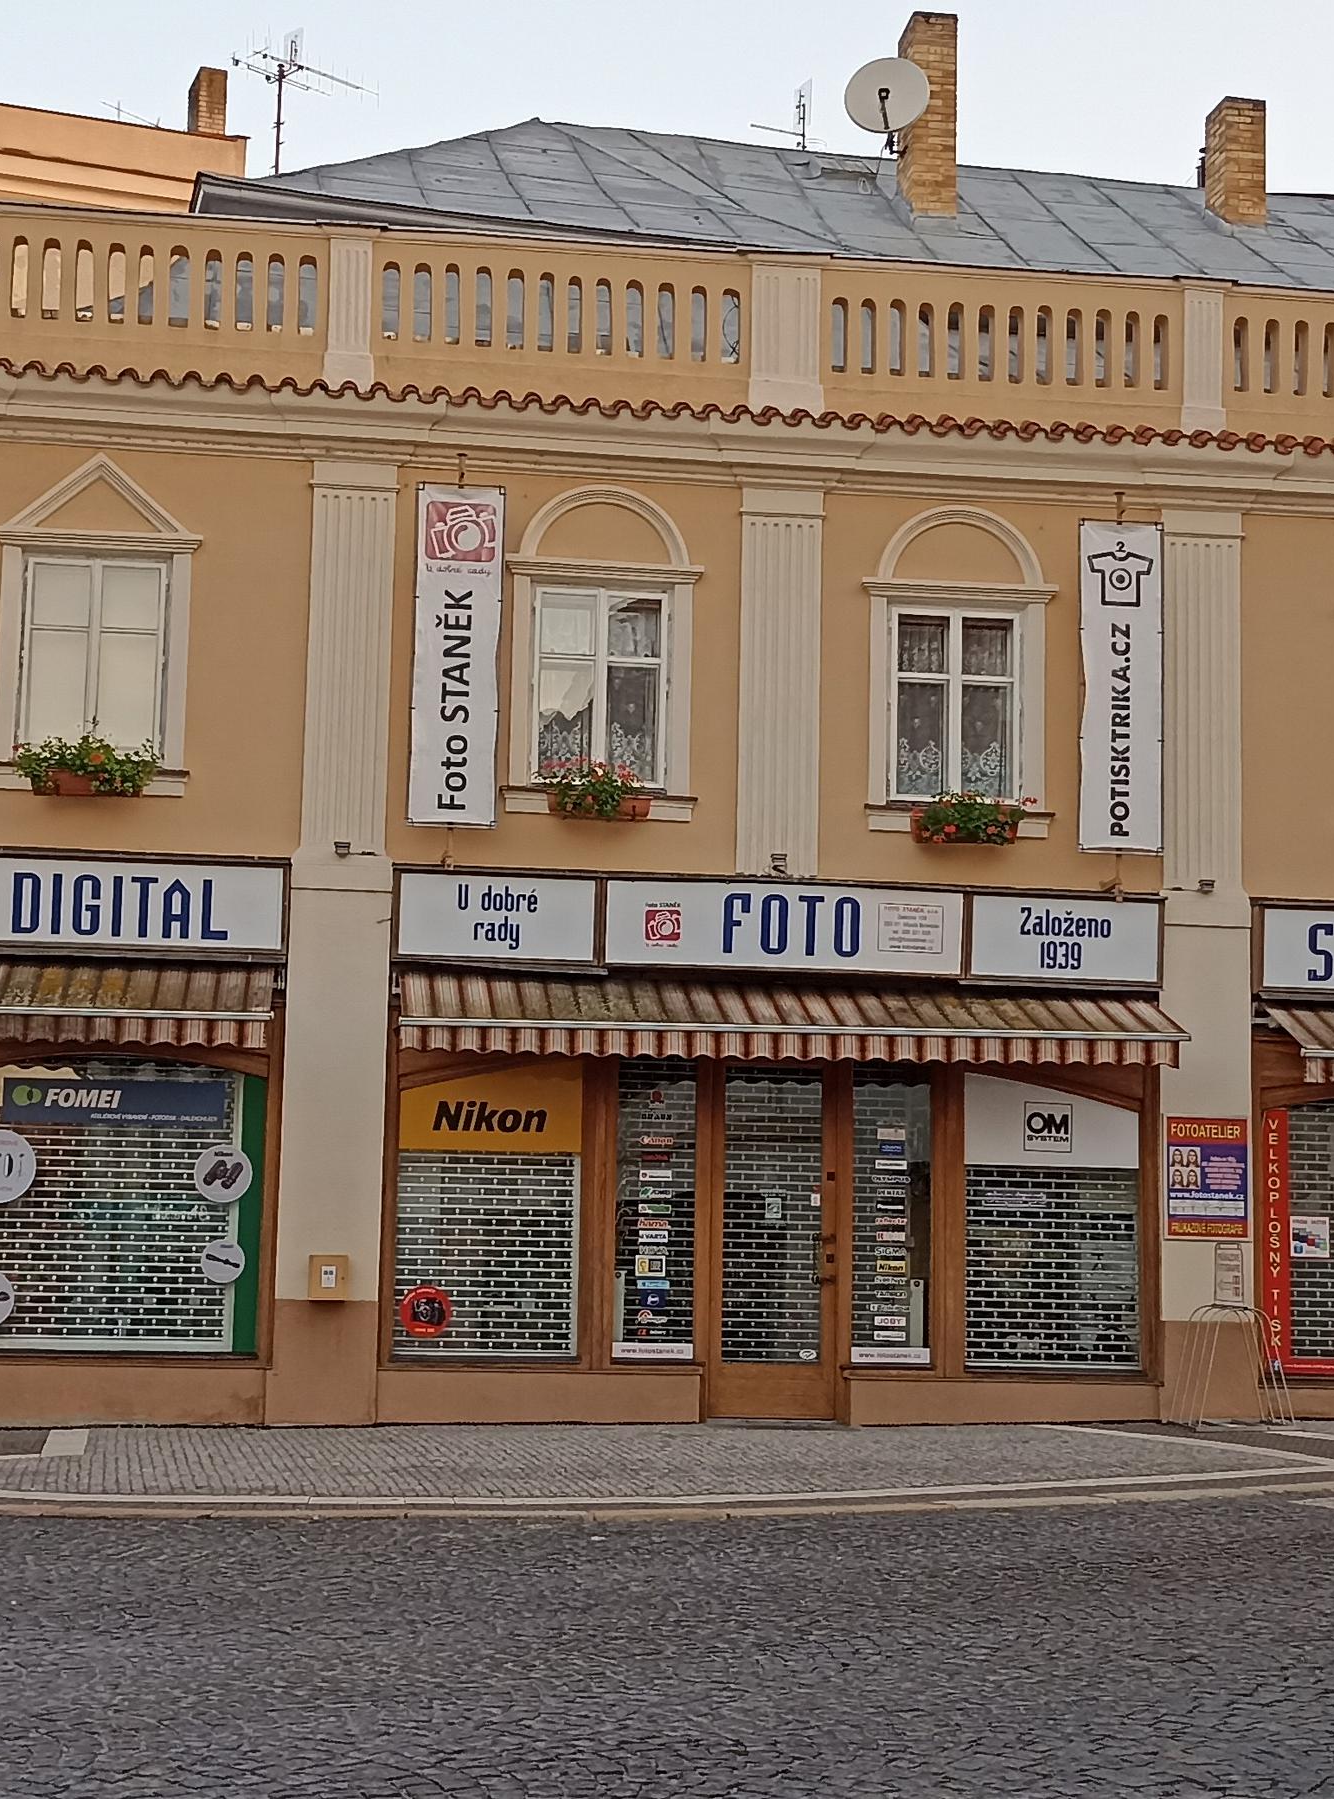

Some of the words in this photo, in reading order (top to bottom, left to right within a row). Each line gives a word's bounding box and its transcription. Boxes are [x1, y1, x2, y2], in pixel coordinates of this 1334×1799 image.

[435, 589, 474, 724] STANĚK
[1109, 622, 1131, 837] POTISKTRIKA.CZ
[436, 735, 468, 811] Foto
[11, 872, 229, 941] DIGITAL
[457, 883, 469, 911] U
[481, 885, 538, 913] dobré
[473, 915, 520, 951] rady
[722, 892, 861, 958] FOTO
[1019, 906, 1112, 939] Založeno
[1040, 940, 1082, 970] 1939
[44, 1088, 122, 1109] FOMEI
[432, 1101, 548, 1133] Nikon
[1027, 1111, 1069, 1135] OM
[1170, 1121, 1241, 1139] FOTOATELIÉR
[1027, 1134, 1069, 1143] SYSTEM
[1169, 1190, 1245, 1200] www.fotostanek.cz
[875, 1247, 907, 1256] SIGMA
[878, 1263, 904, 1271] Nikon
[1270, 1289, 1282, 1347] TISK
